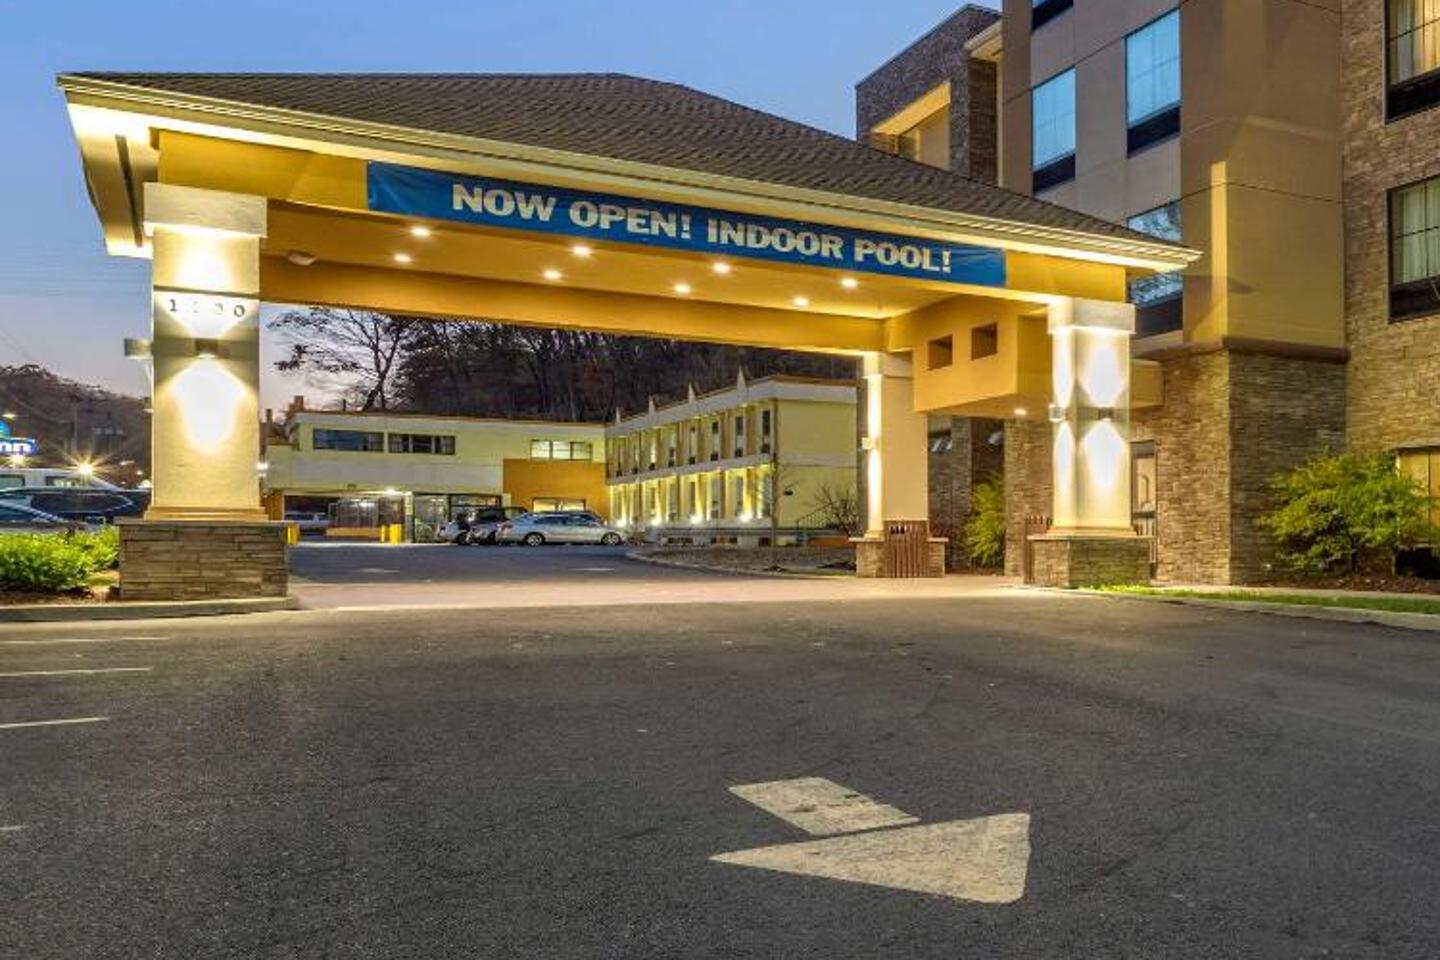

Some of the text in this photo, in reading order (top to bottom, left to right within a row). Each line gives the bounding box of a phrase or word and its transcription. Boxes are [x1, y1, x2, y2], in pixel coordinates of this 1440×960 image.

[452, 183, 952, 274] NOW OPEN! INDOOR POOL!
